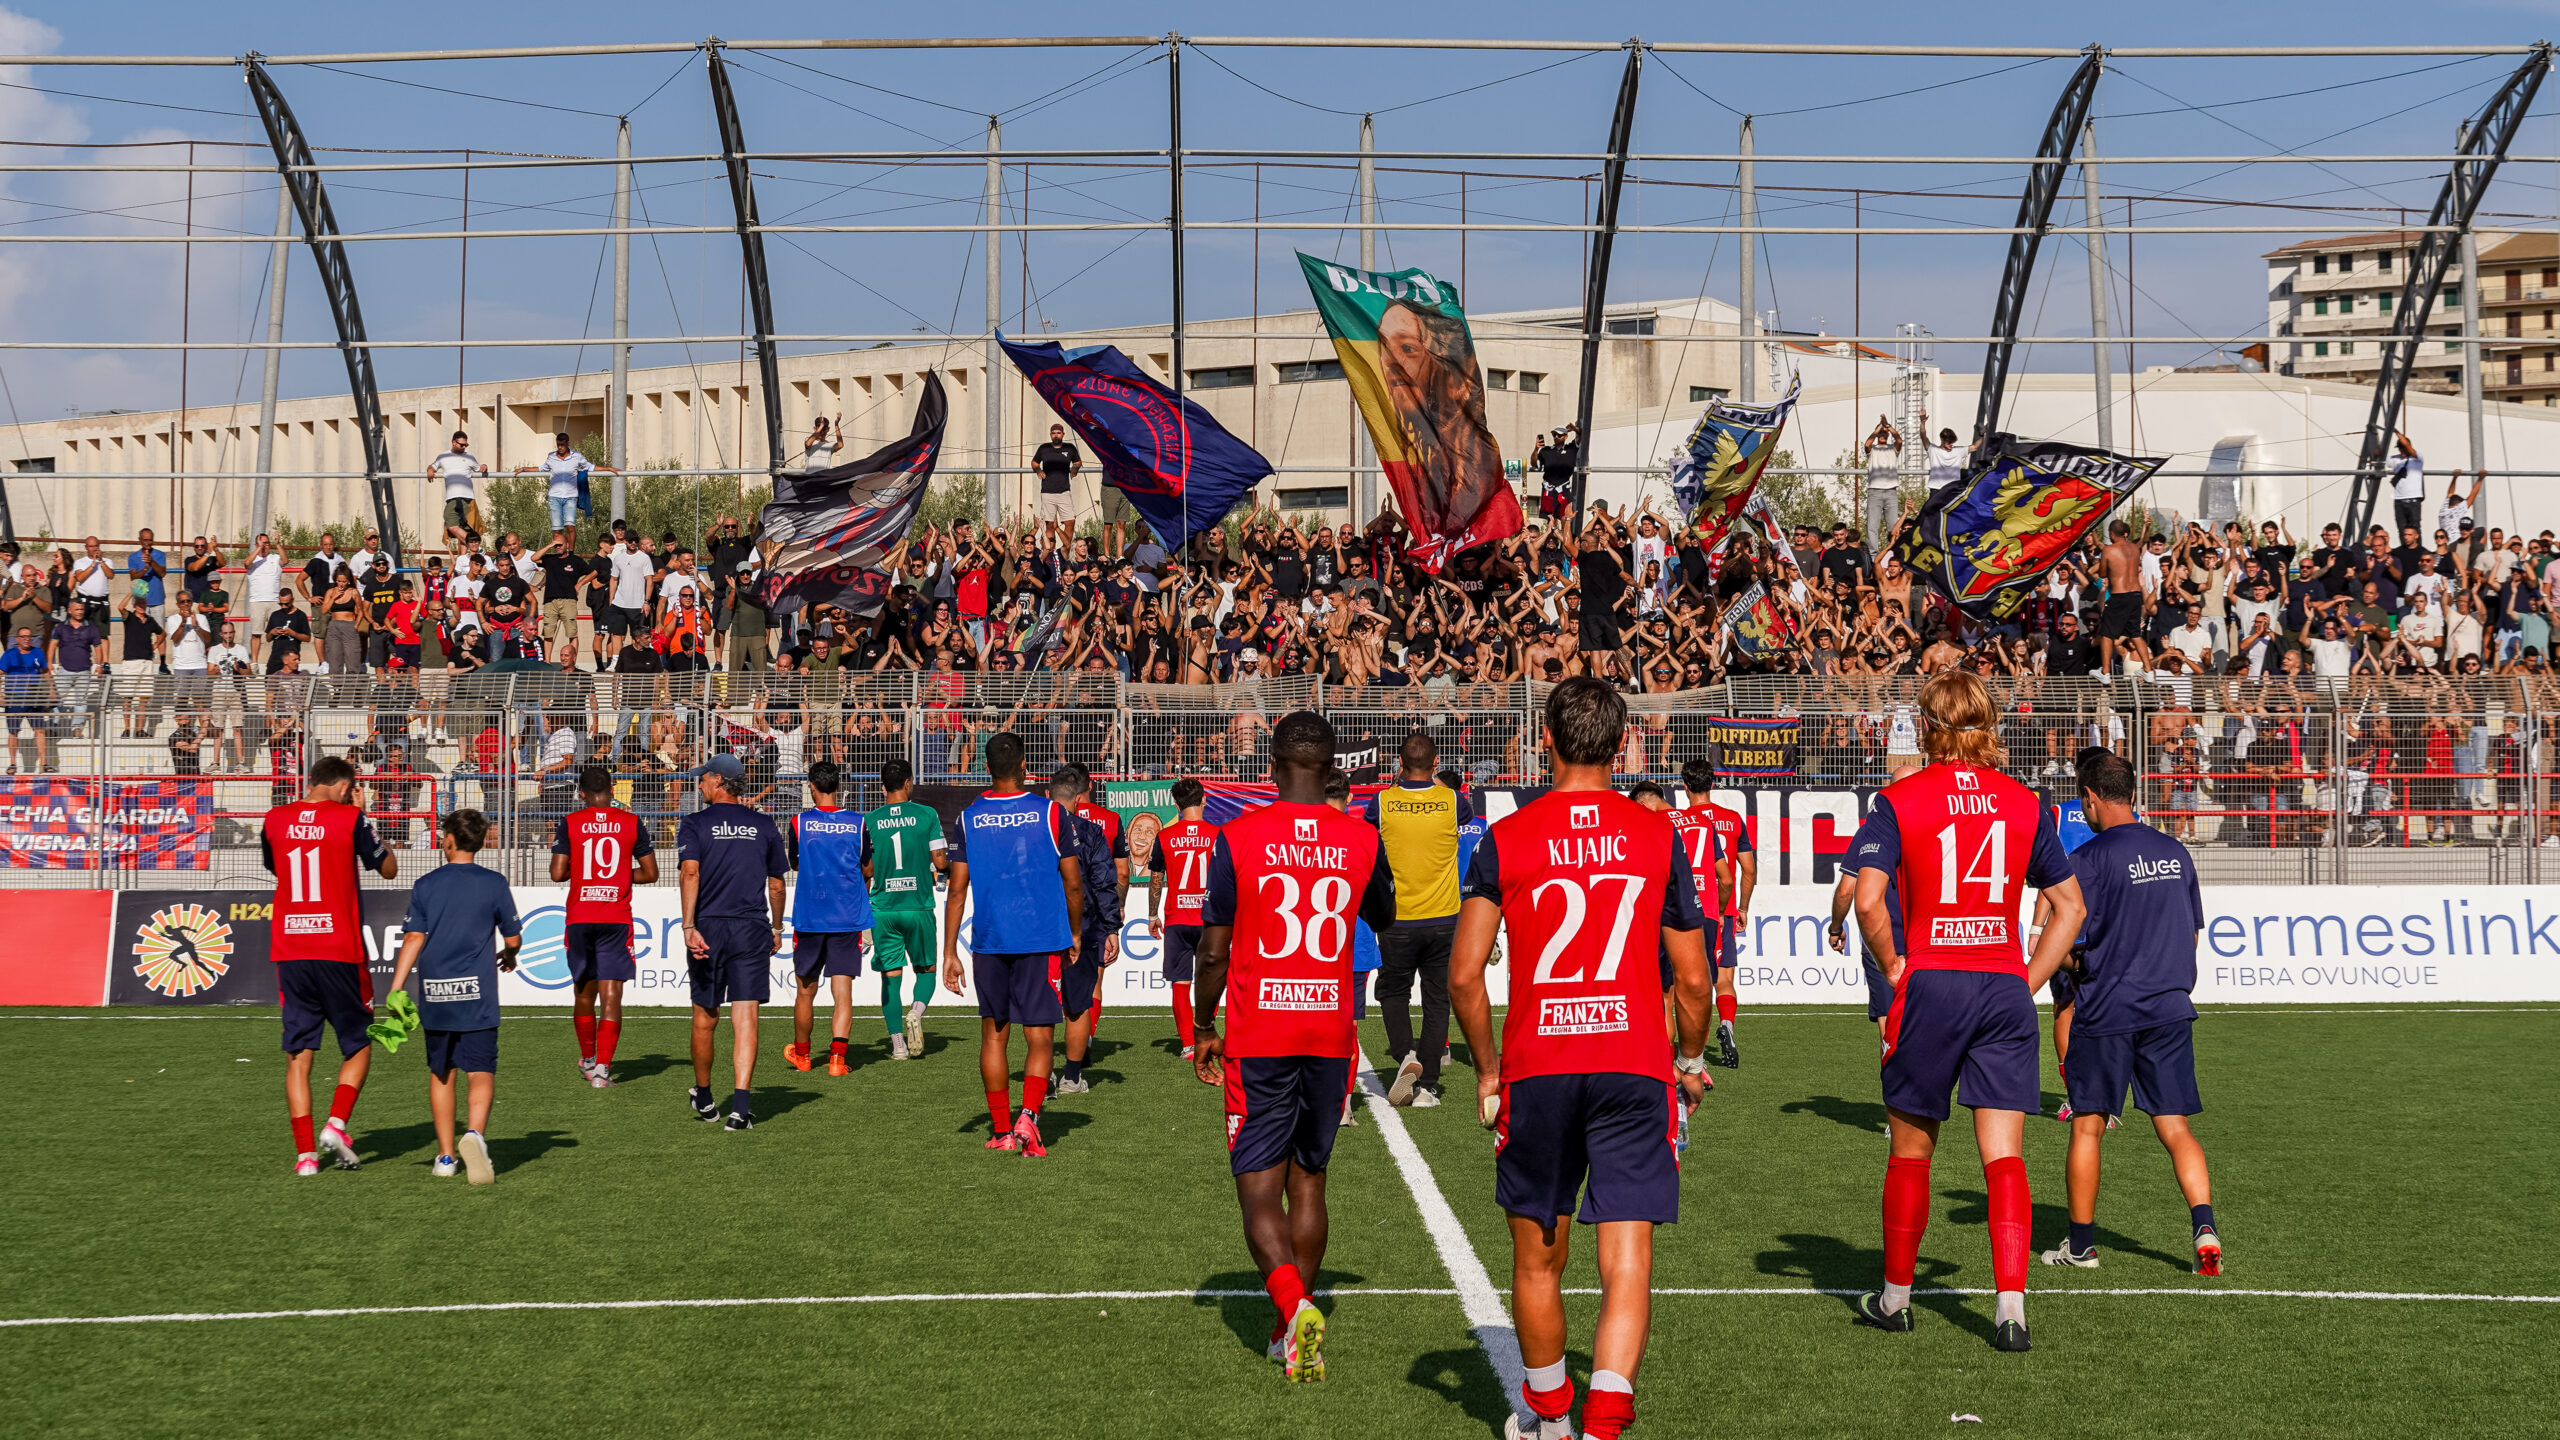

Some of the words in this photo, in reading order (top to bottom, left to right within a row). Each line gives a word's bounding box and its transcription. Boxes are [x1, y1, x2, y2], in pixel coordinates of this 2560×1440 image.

[1077, 377, 1133, 396] RIONE
[1709, 727, 1798, 745] DIFFIDATI
[1724, 750, 1784, 766] LIBERI
[1108, 790, 1148, 808] BIONDO
[1388, 801, 1448, 813] Kappa
[1947, 794, 1998, 815] DUDIC
[76, 807, 189, 825] GUARDIA
[877, 816, 917, 830] ROMANO
[973, 811, 1040, 828] Kappa
[285, 824, 325, 840] ASERO
[581, 822, 621, 834] CASTILLO
[805, 820, 858, 834] Kappa
[1457, 824, 1482, 835] ppa
[1712, 820, 1734, 832] ATLEY
[12, 834, 138, 851] VIGNAZZA
[890, 831, 903, 870] 1
[1170, 836, 1211, 848] CAPPELLO
[1547, 829, 1627, 869] KLJAJIĆ
[582, 837, 621, 880] 19
[1265, 843, 1348, 870] SANGARE
[1936, 820, 2010, 904] 14
[286, 846, 322, 902] 11
[1174, 850, 1208, 890] 71
[580, 886, 619, 898] FRANZY'S
[229, 903, 273, 921] H24
[284, 913, 333, 929] FRANZY'S
[1258, 872, 1352, 963] 38
[1531, 873, 1647, 985] 27
[1931, 916, 2007, 938] FRANZY'S
[2208, 899, 2560, 958] ermeslink
[369, 965, 418, 973] ellns
[1739, 967, 1792, 986] BRA
[2216, 967, 2294, 986] FIBRA
[2301, 966, 2438, 988] OVUNQUE
[424, 976, 480, 996] FRANZY'S
[634, 969, 692, 989] IBRA
[1259, 978, 1339, 1002] FRANZY'S
[1539, 995, 1628, 1025] FRANZY'S
